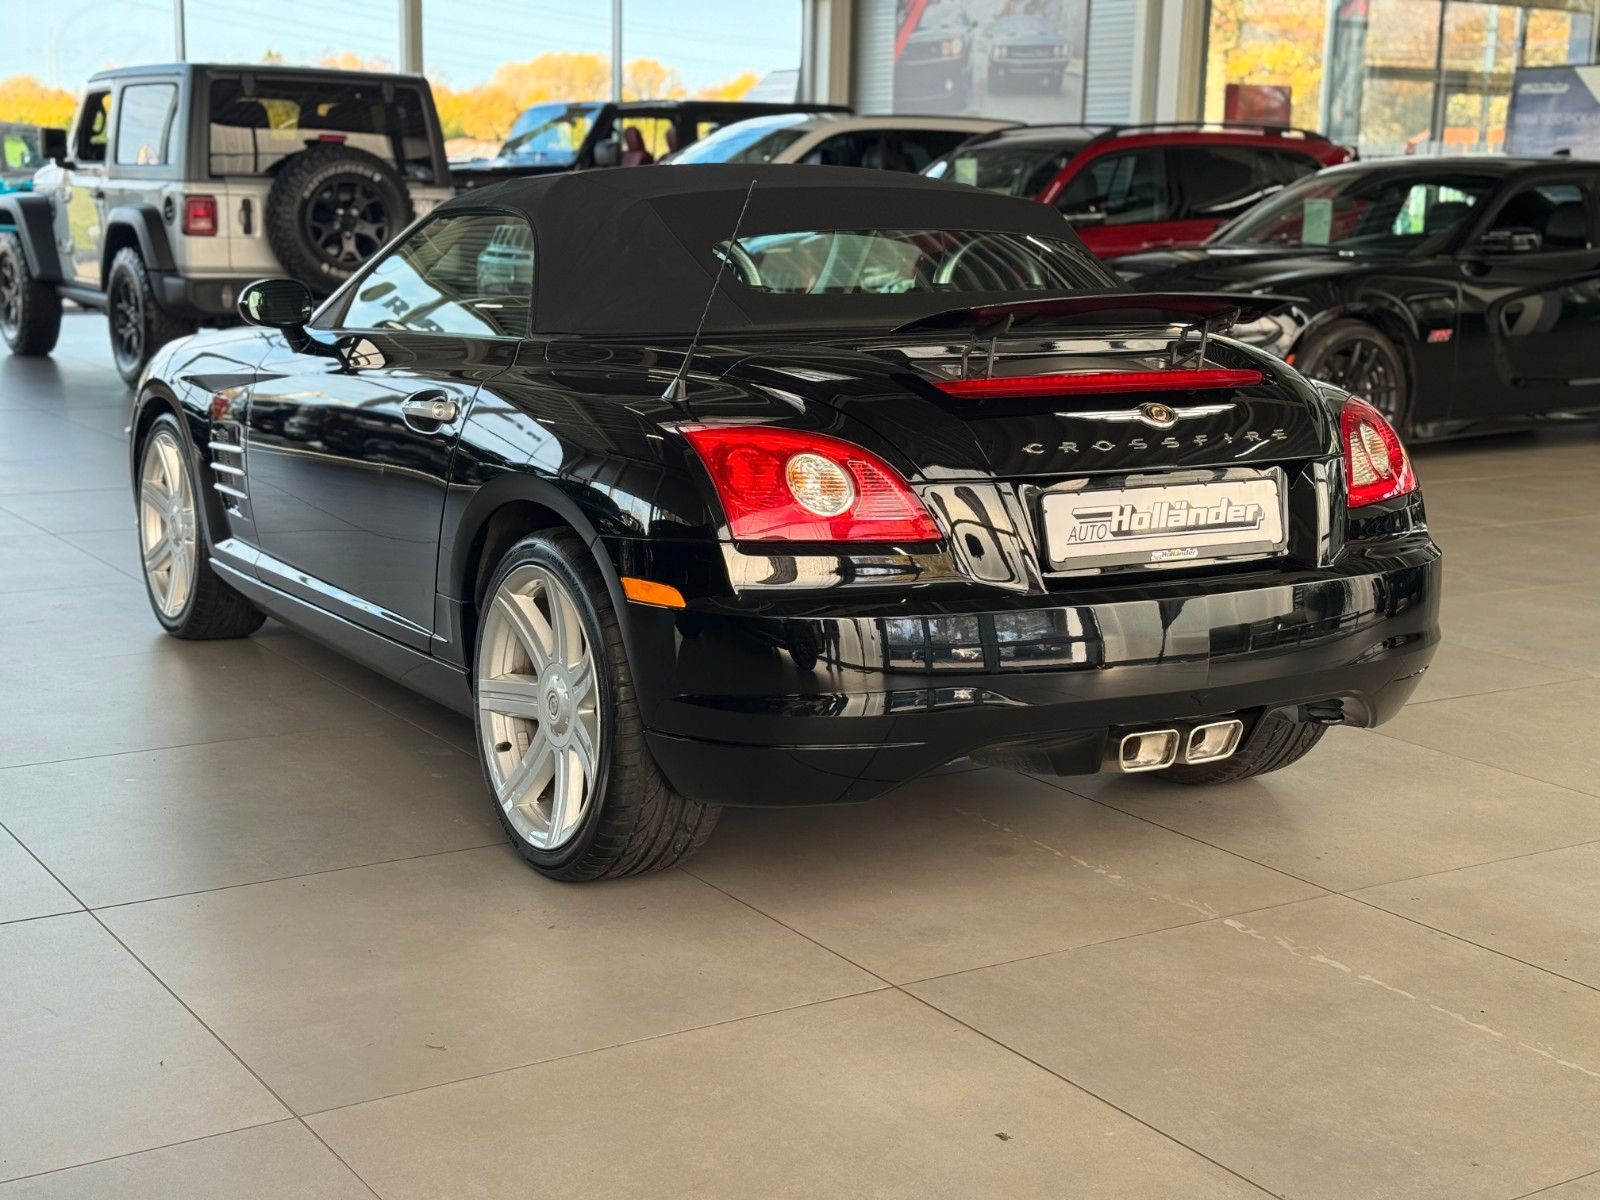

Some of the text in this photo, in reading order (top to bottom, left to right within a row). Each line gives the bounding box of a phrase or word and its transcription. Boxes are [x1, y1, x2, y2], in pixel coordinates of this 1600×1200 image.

[1022, 429, 1289, 455] CROSSFIRE
[1068, 497, 1264, 542] AUTO Holländer
